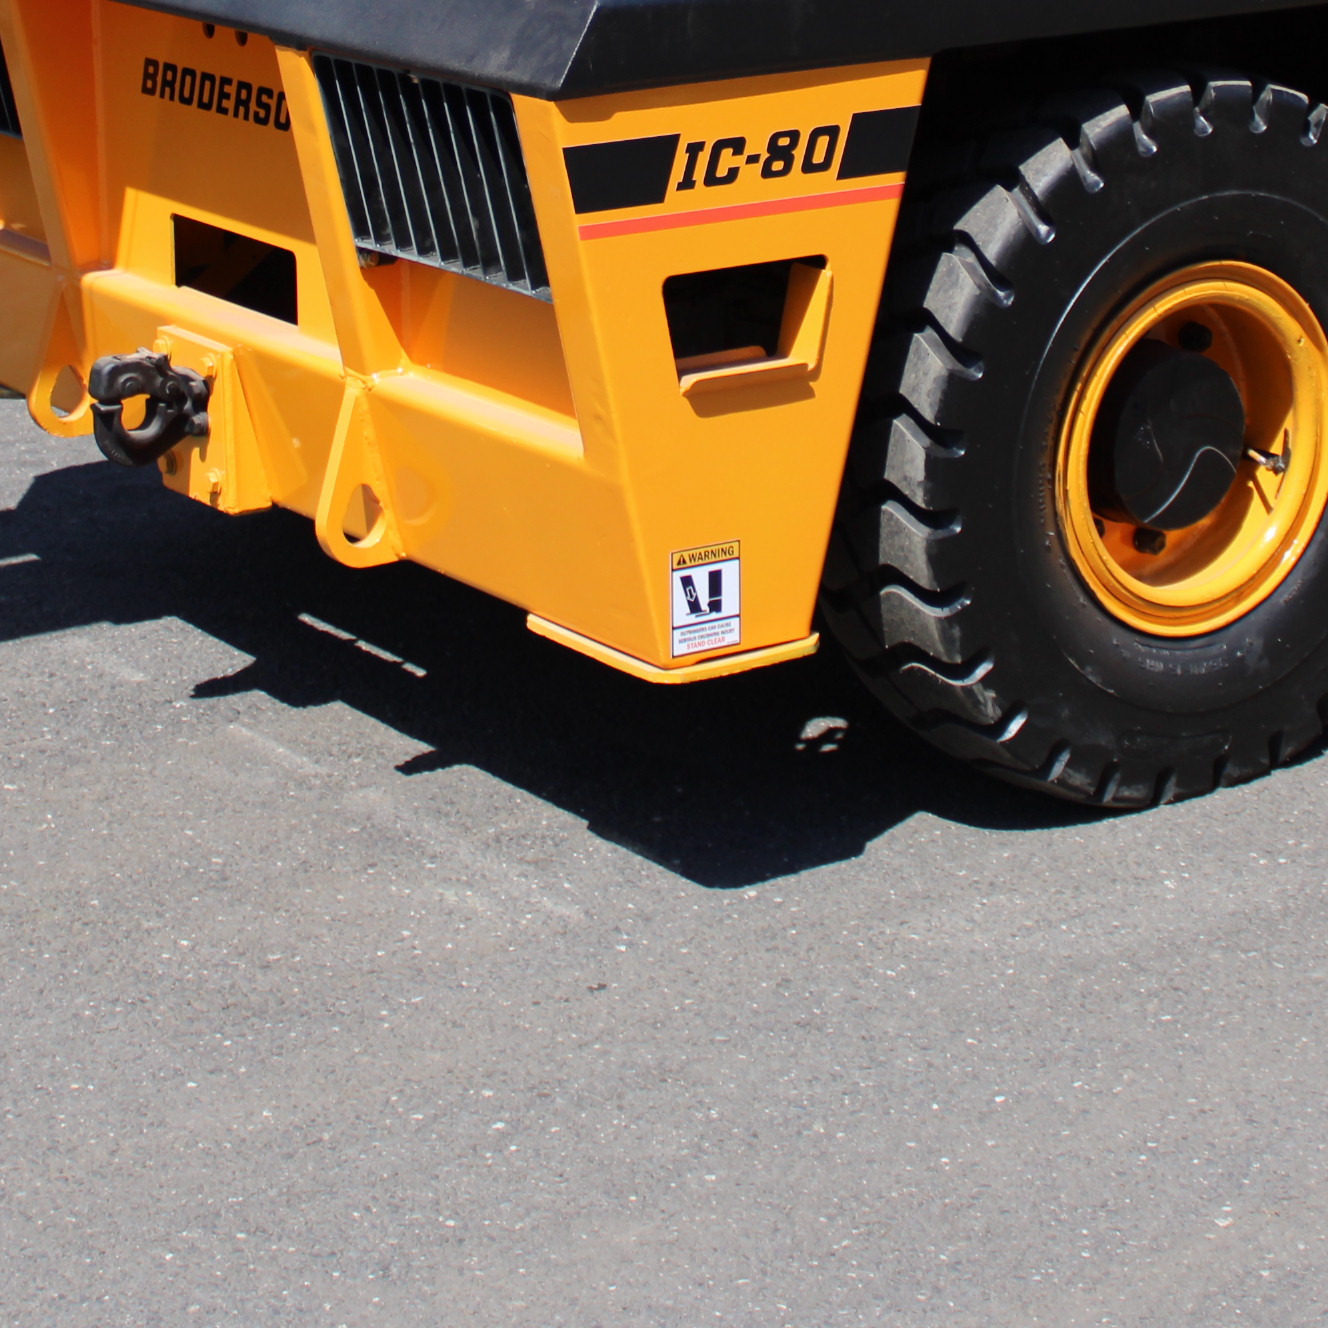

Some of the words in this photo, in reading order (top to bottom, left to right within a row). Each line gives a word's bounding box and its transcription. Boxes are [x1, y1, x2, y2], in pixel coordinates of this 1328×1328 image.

[141, 57, 292, 132] BRODERSO
[676, 124, 841, 192] IC-80
[688, 545, 735, 564] WARNING
[686, 640, 706, 650] STAND
[707, 636, 726, 646] CLEAR
